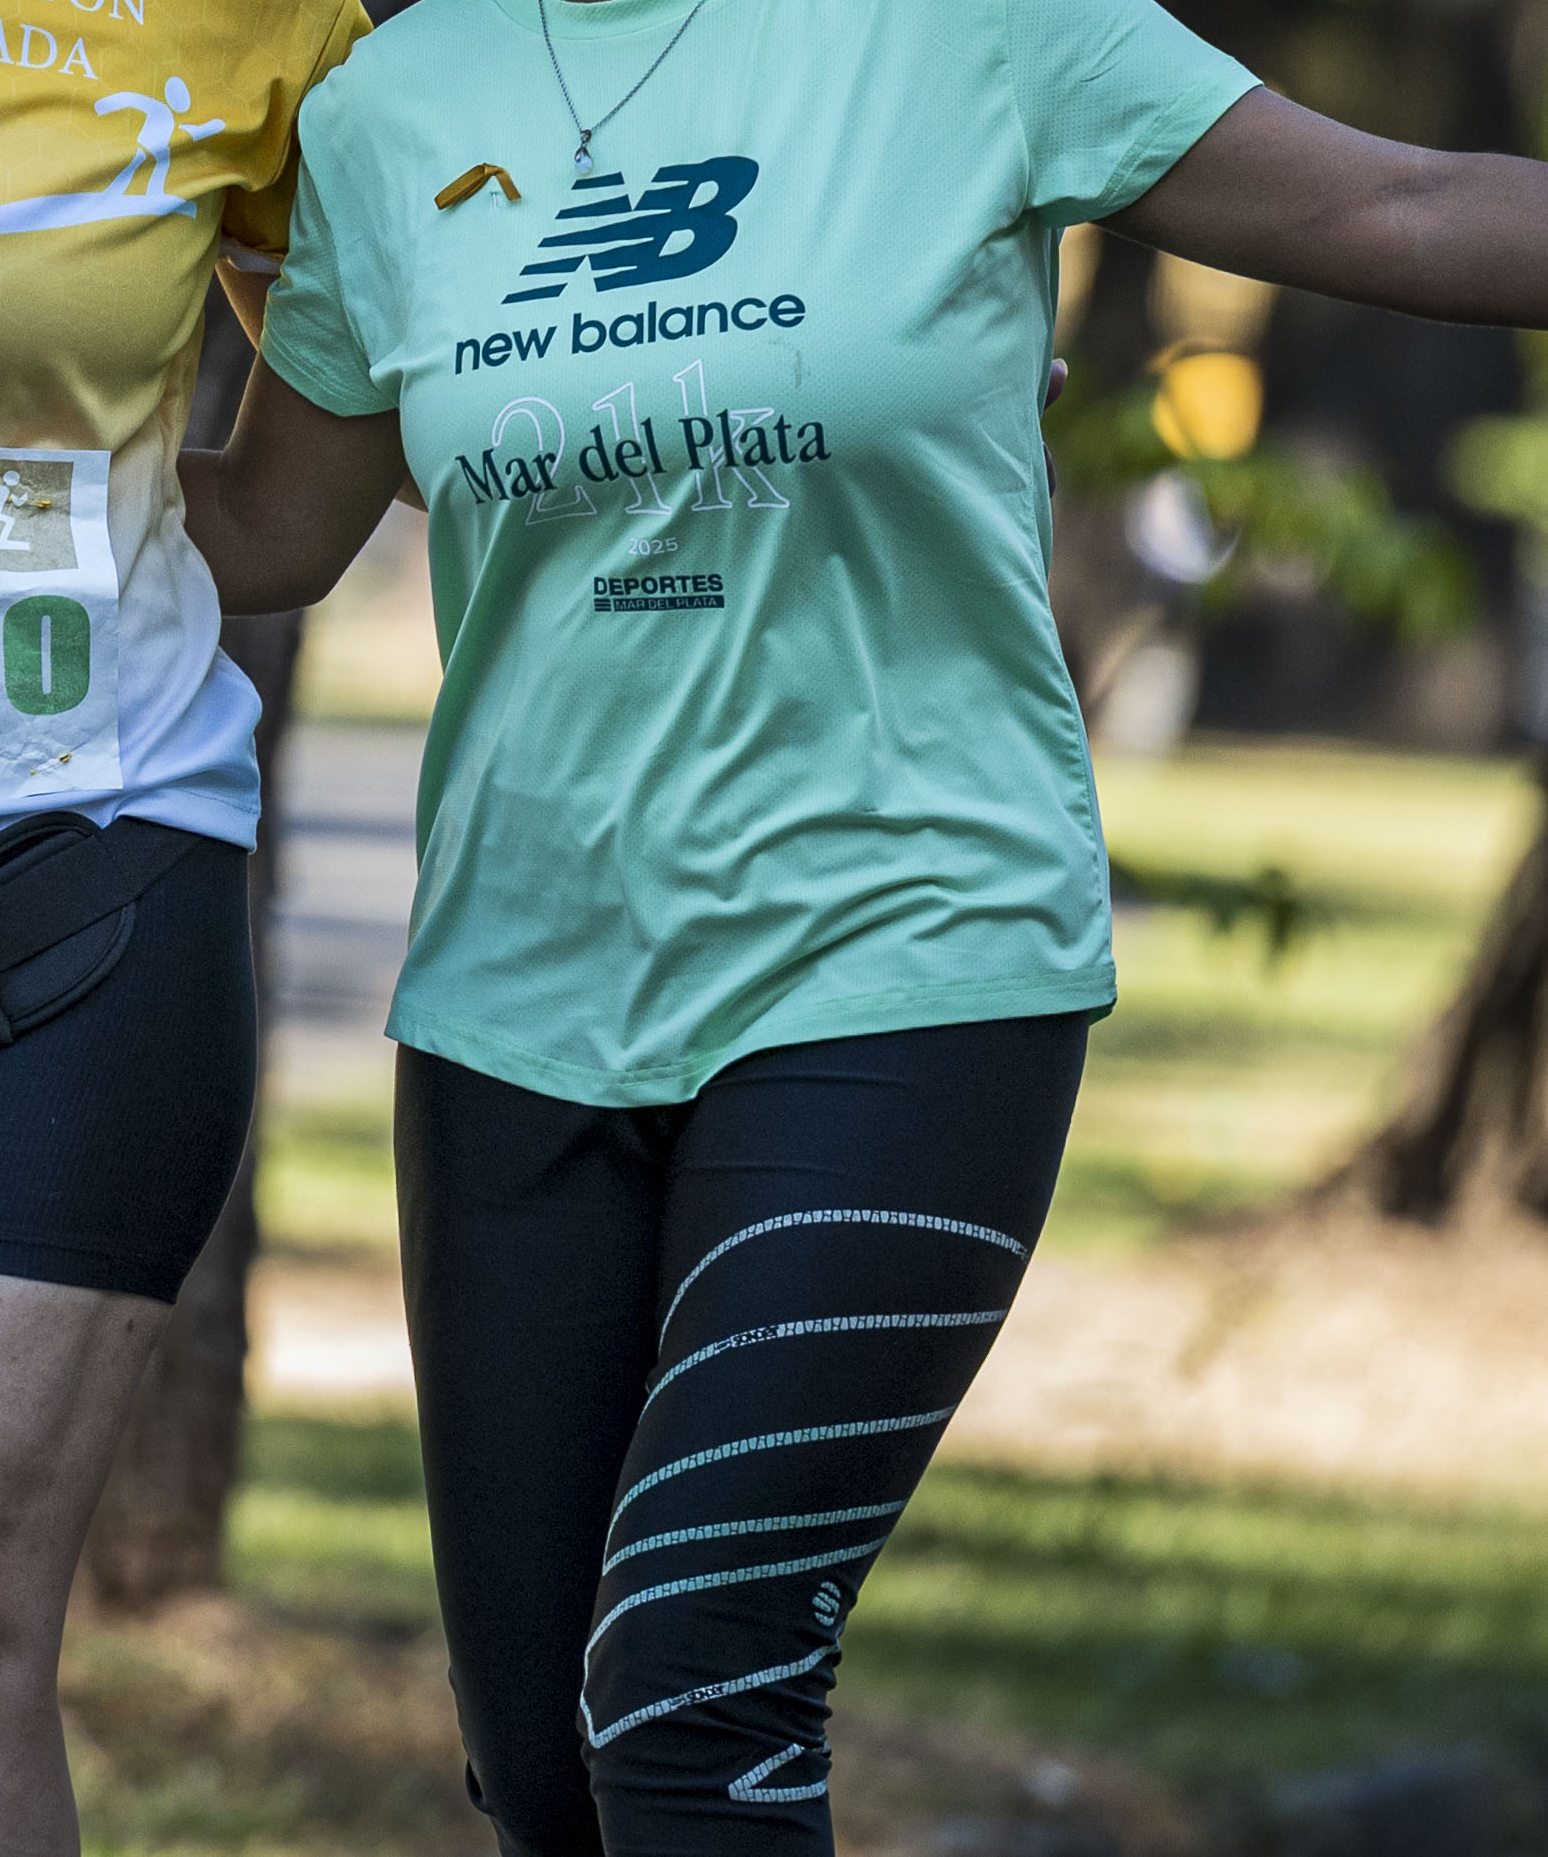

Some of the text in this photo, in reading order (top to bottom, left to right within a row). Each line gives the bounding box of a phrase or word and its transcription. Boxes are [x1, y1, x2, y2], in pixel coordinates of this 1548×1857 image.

[454, 293, 806, 375] new balance
[454, 408, 832, 505] Mar del Plata
[628, 537, 679, 556] 2025
[593, 573, 724, 596] DEPORTES
[615, 596, 717, 610] MAR DEL PLATA
